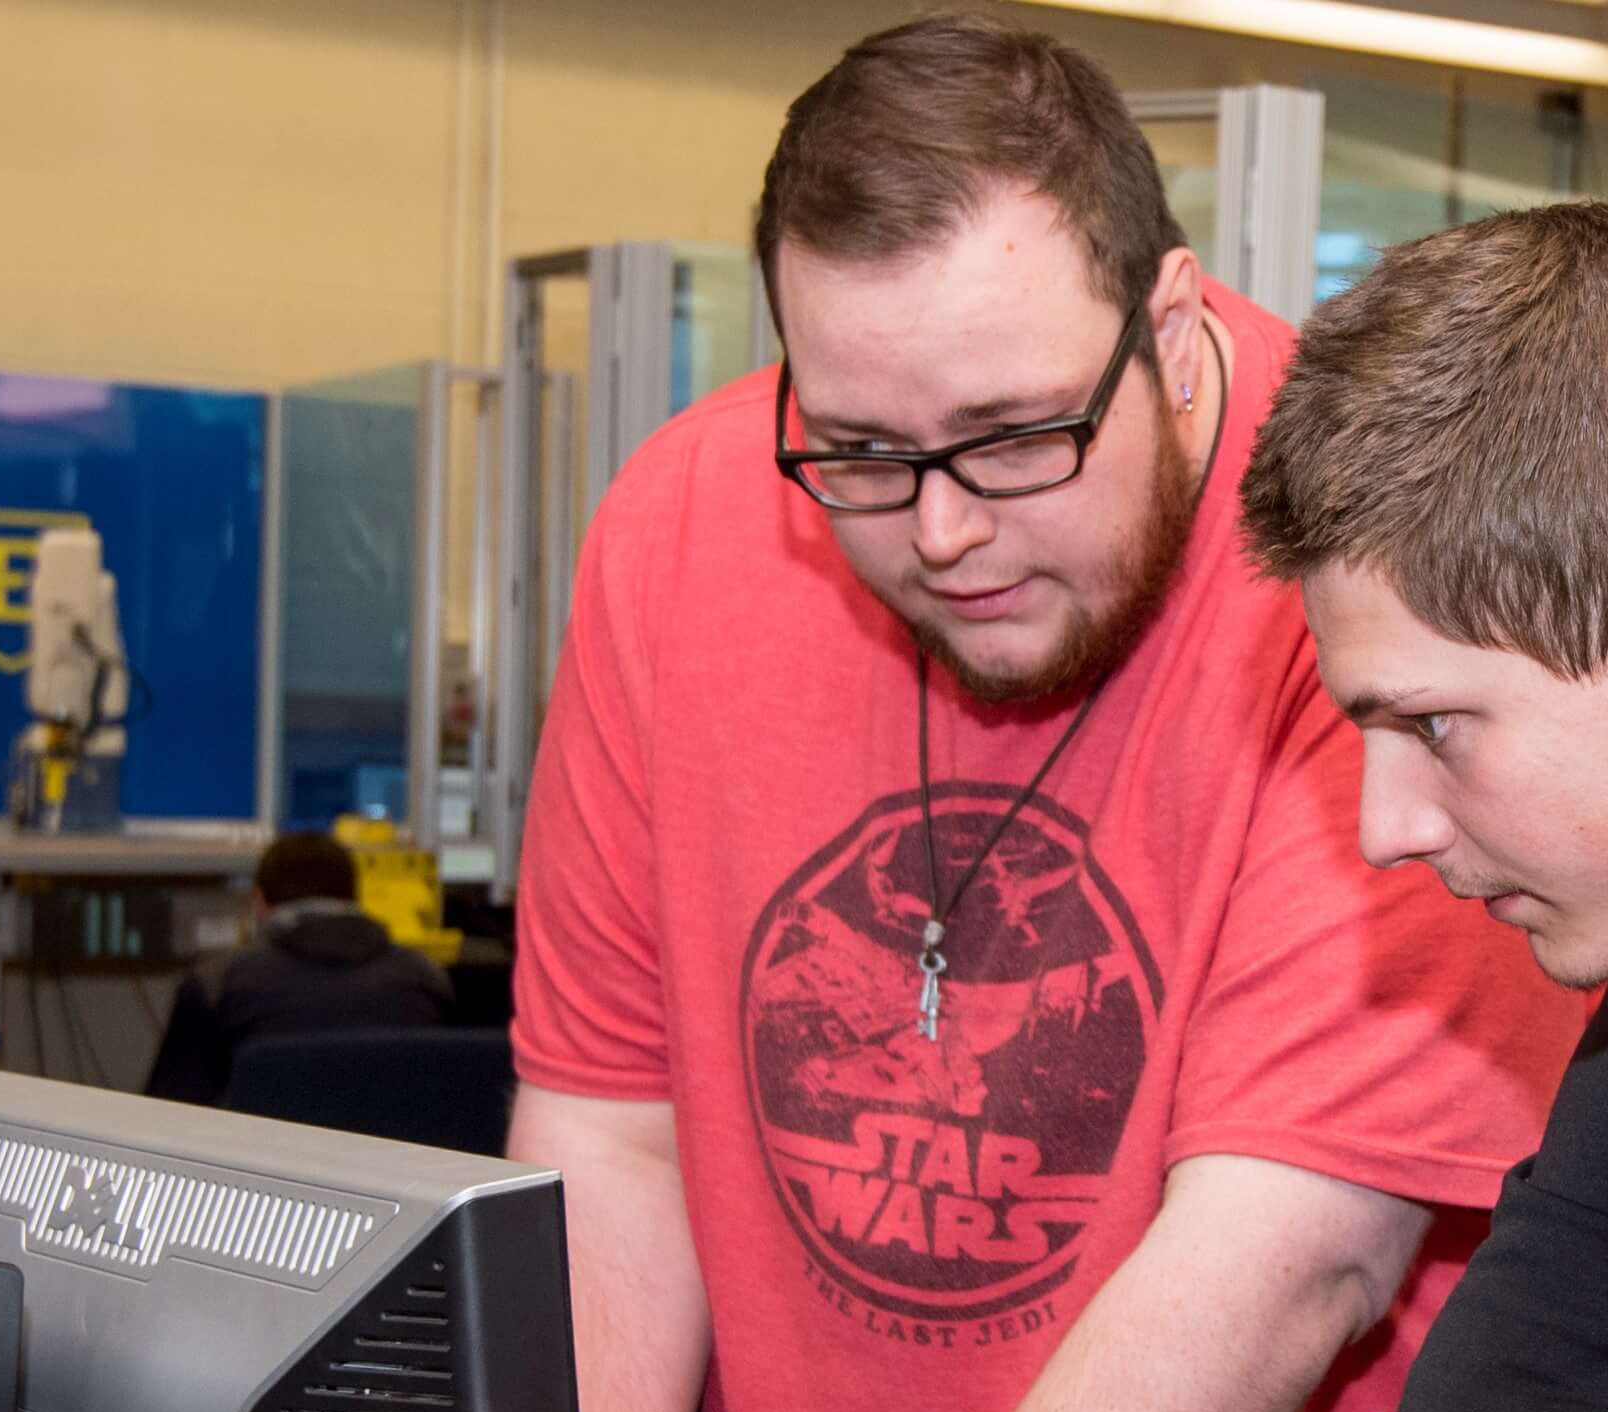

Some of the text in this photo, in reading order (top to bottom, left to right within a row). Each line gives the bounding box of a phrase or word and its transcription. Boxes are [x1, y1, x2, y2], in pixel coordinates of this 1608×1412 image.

[782, 1112, 1110, 1200] STAR
[786, 1168, 1095, 1263] WARS
[802, 1257, 1057, 1348] THE LAST JEDI
